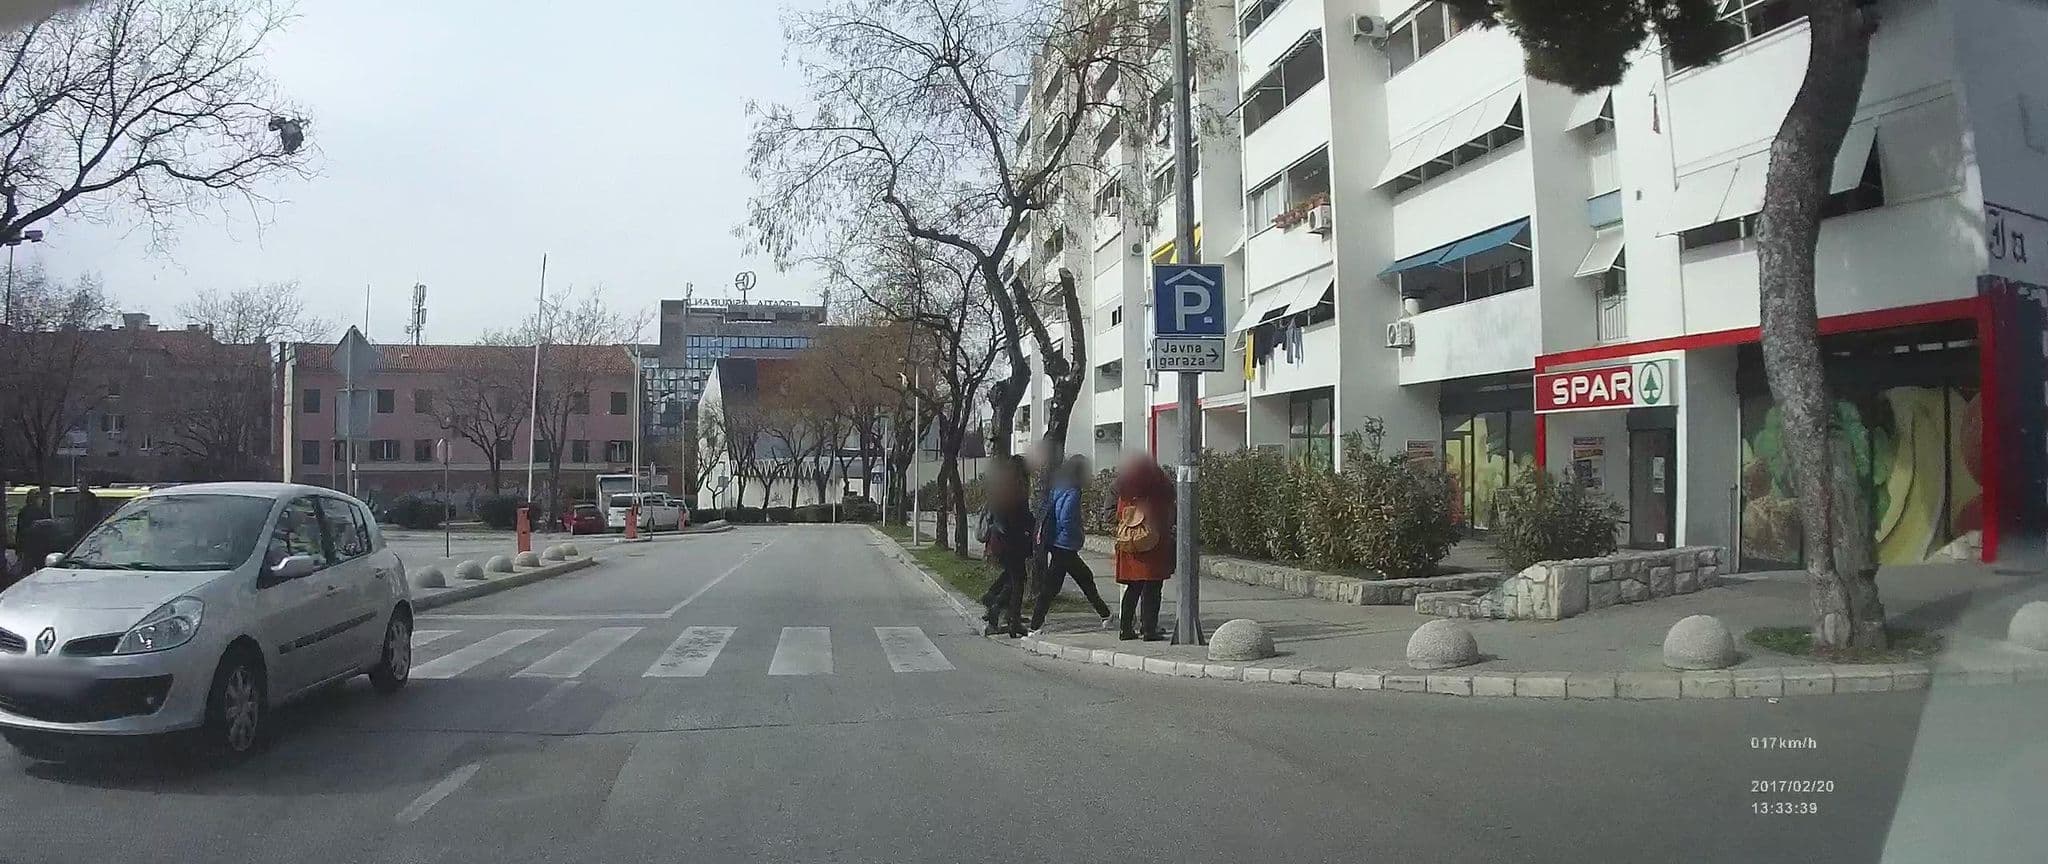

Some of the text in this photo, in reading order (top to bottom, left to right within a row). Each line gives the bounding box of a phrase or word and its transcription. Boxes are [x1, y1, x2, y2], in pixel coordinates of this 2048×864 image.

[1175, 284, 1211, 331] P
[1161, 342, 1202, 353] Javna
[1552, 371, 1632, 405] SPAR
